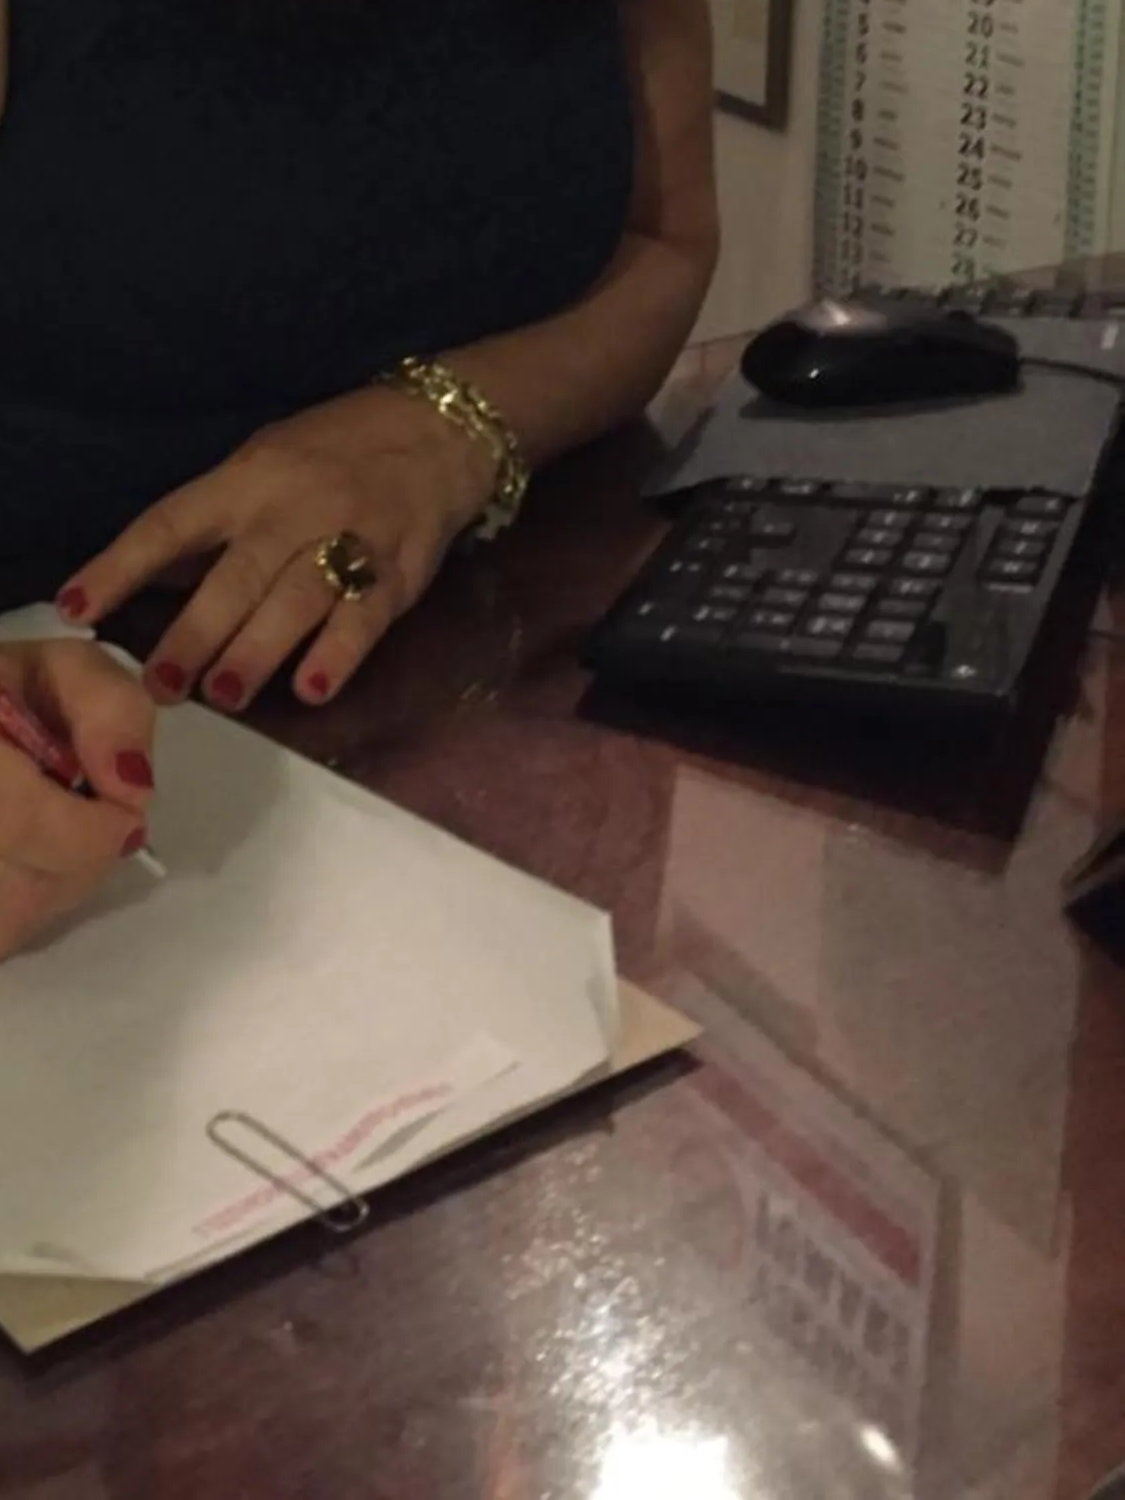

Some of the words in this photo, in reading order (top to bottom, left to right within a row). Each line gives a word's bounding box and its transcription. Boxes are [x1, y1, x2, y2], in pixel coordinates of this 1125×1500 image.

[967, 11, 993, 39] 20
[965, 41, 989, 69] 21
[964, 72, 988, 98] 22
[960, 102, 986, 130] 23
[958, 131, 984, 160] 24
[957, 161, 982, 190] 25
